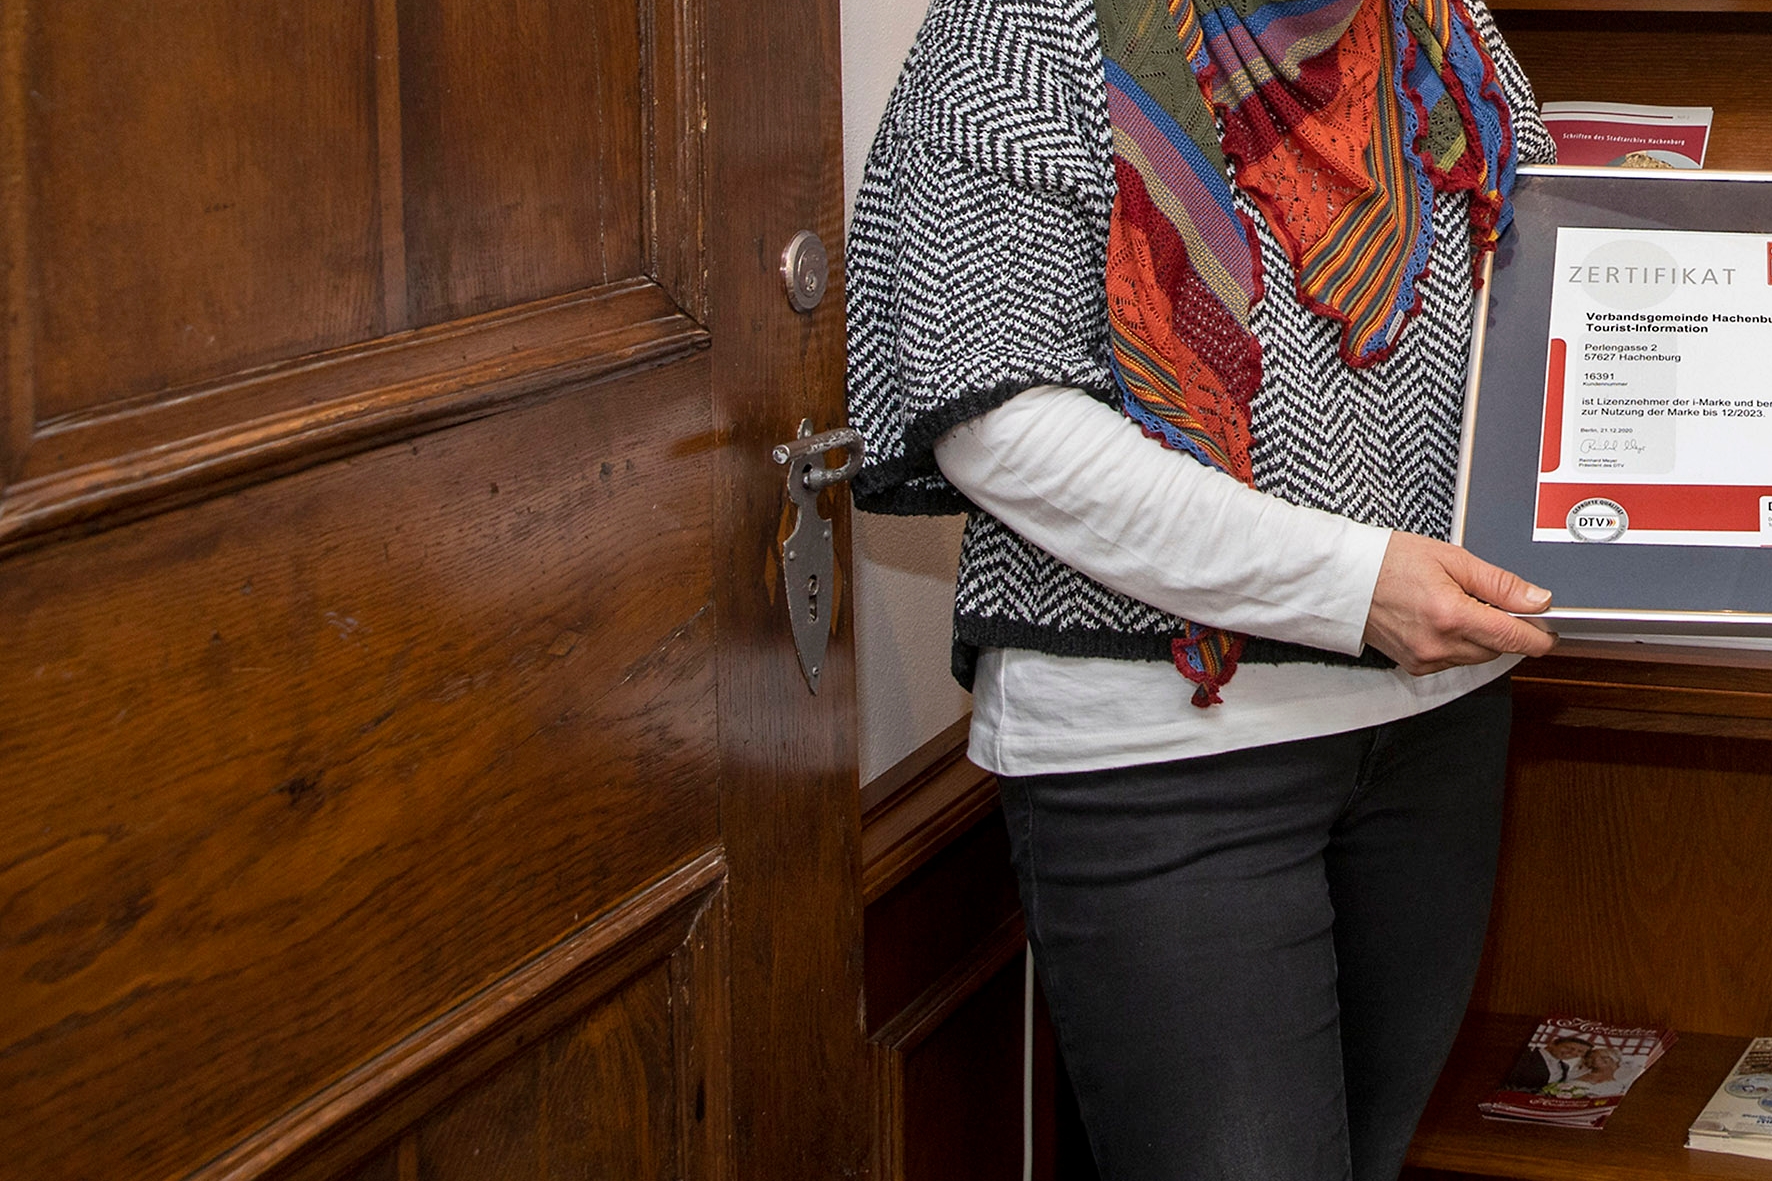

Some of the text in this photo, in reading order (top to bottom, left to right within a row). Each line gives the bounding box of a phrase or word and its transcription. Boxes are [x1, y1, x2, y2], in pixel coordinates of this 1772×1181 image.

[1562, 132, 1686, 146] Schriften des Stadtarchivs Hachenburg
[1568, 266, 1737, 286] ZERTIFIKAT
[1586, 312, 1709, 324] Verbandsgemeinde
[1585, 323, 1709, 333] Tourist-Information
[1584, 343, 1658, 353] Perlengasse 2
[1584, 353, 1682, 363] 57627 Hachenburg
[1584, 372, 1615, 381] 16391
[1582, 398, 1595, 407] ist
[1596, 398, 1670, 407] Lizenznehmer
[1672, 398, 1690, 407] der
[1692, 398, 1732, 408] i-Marke
[1734, 399, 1754, 408] und
[1581, 408, 1766, 418] zur Nutzung der Marke bis 12/2023.
[1578, 517, 1605, 527] DTV
